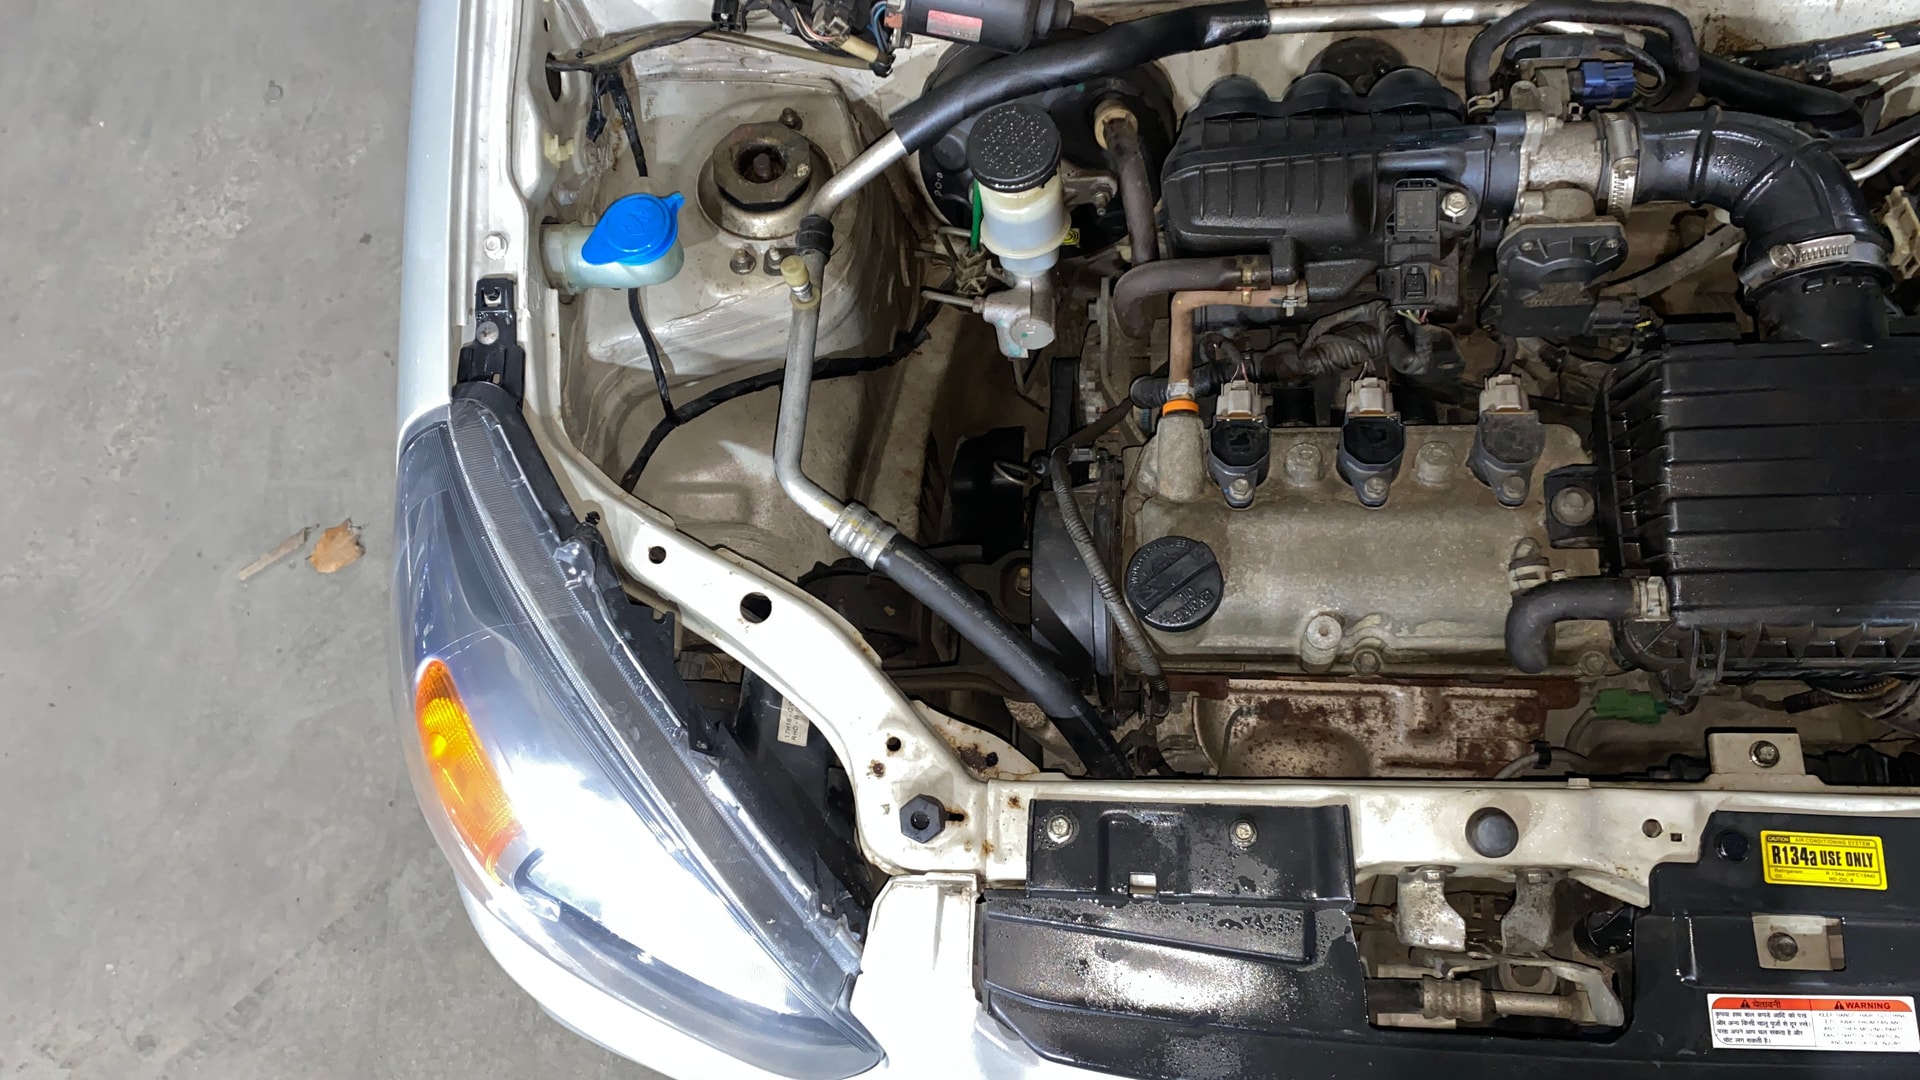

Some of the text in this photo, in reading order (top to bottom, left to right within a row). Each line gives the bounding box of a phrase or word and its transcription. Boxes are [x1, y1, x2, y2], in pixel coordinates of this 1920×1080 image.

[951, 592, 972, 608] ONLY
[1173, 589, 1212, 620] ENGINE
[1806, 838, 1846, 846] CONDITIONING
[1771, 845, 1873, 868] R134a USE ONLY
[1845, 1002, 1891, 1010] WARNING
